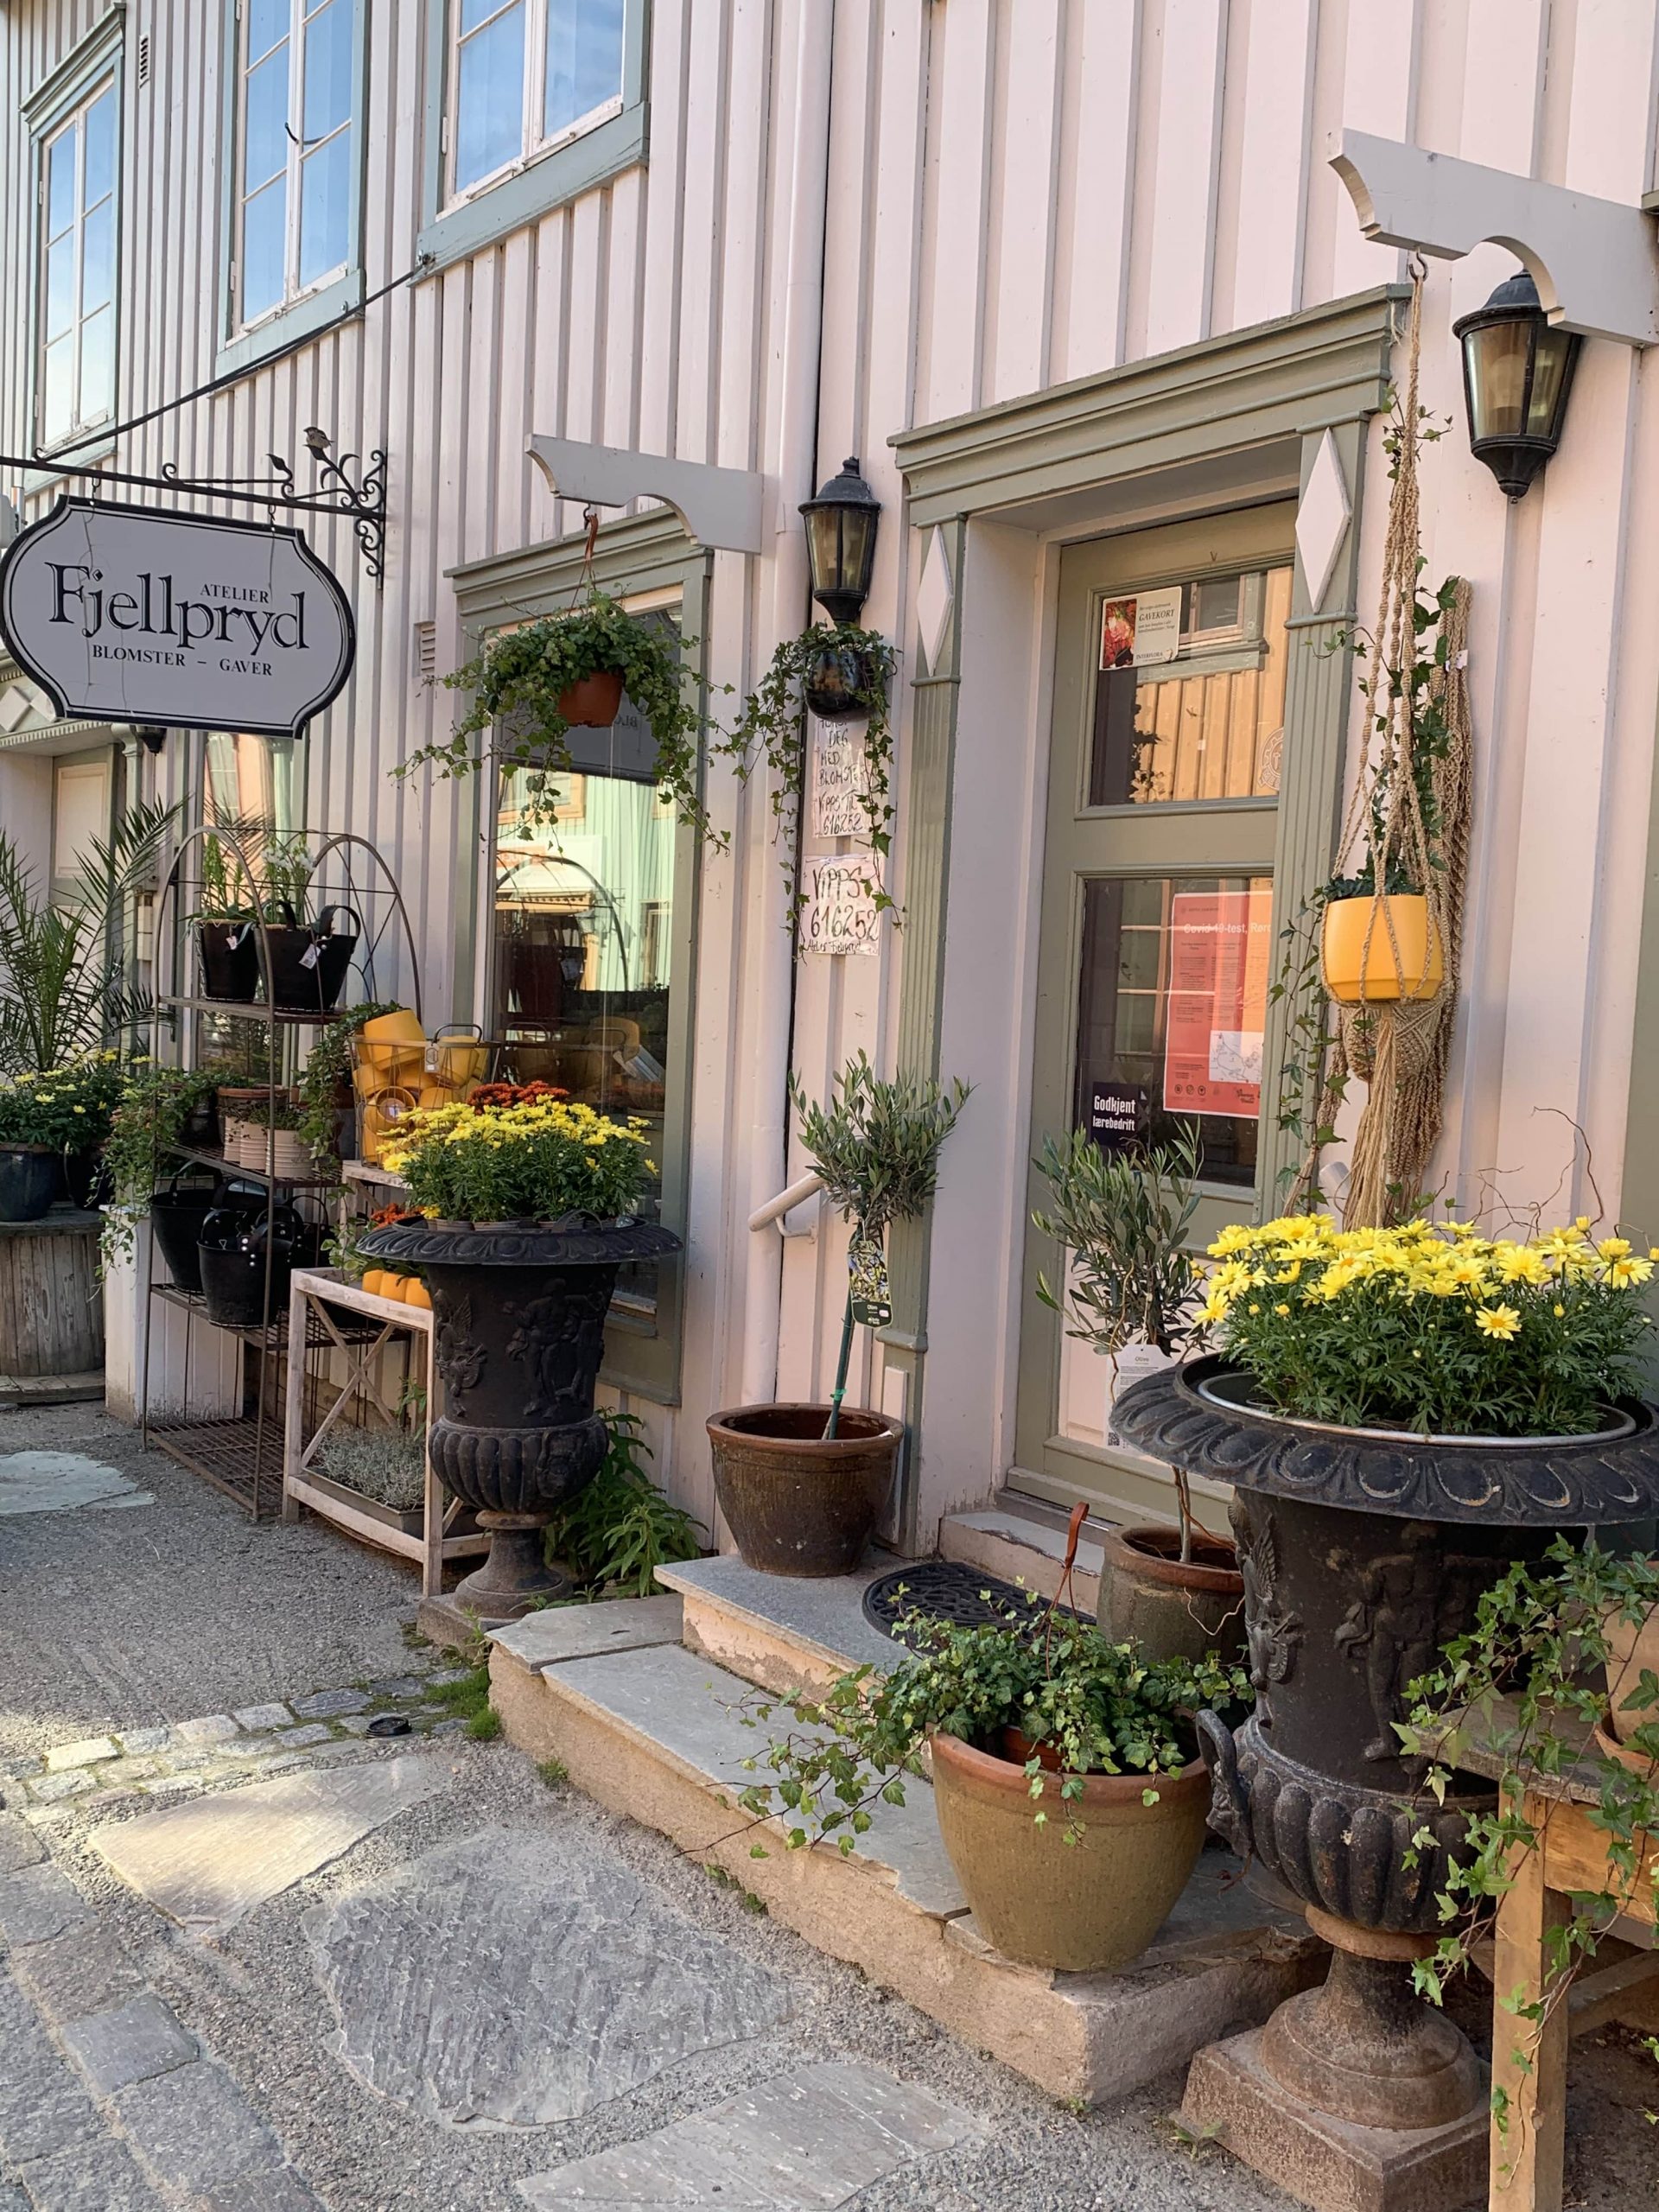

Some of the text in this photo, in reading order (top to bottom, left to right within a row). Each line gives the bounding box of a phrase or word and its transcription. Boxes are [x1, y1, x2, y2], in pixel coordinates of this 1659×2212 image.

[200, 583, 270, 604] ATELIER
[44, 561, 309, 656] Fjellpryd
[1139, 608, 1175, 621] GAVEKORT
[92, 645, 186, 667] BLOMSTER
[219, 658, 272, 677] GAVER
[810, 905, 878, 941] 616252
[1094, 1095, 1136, 1116] Godkjent
[1092, 1115, 1135, 1131] lærebedrift
